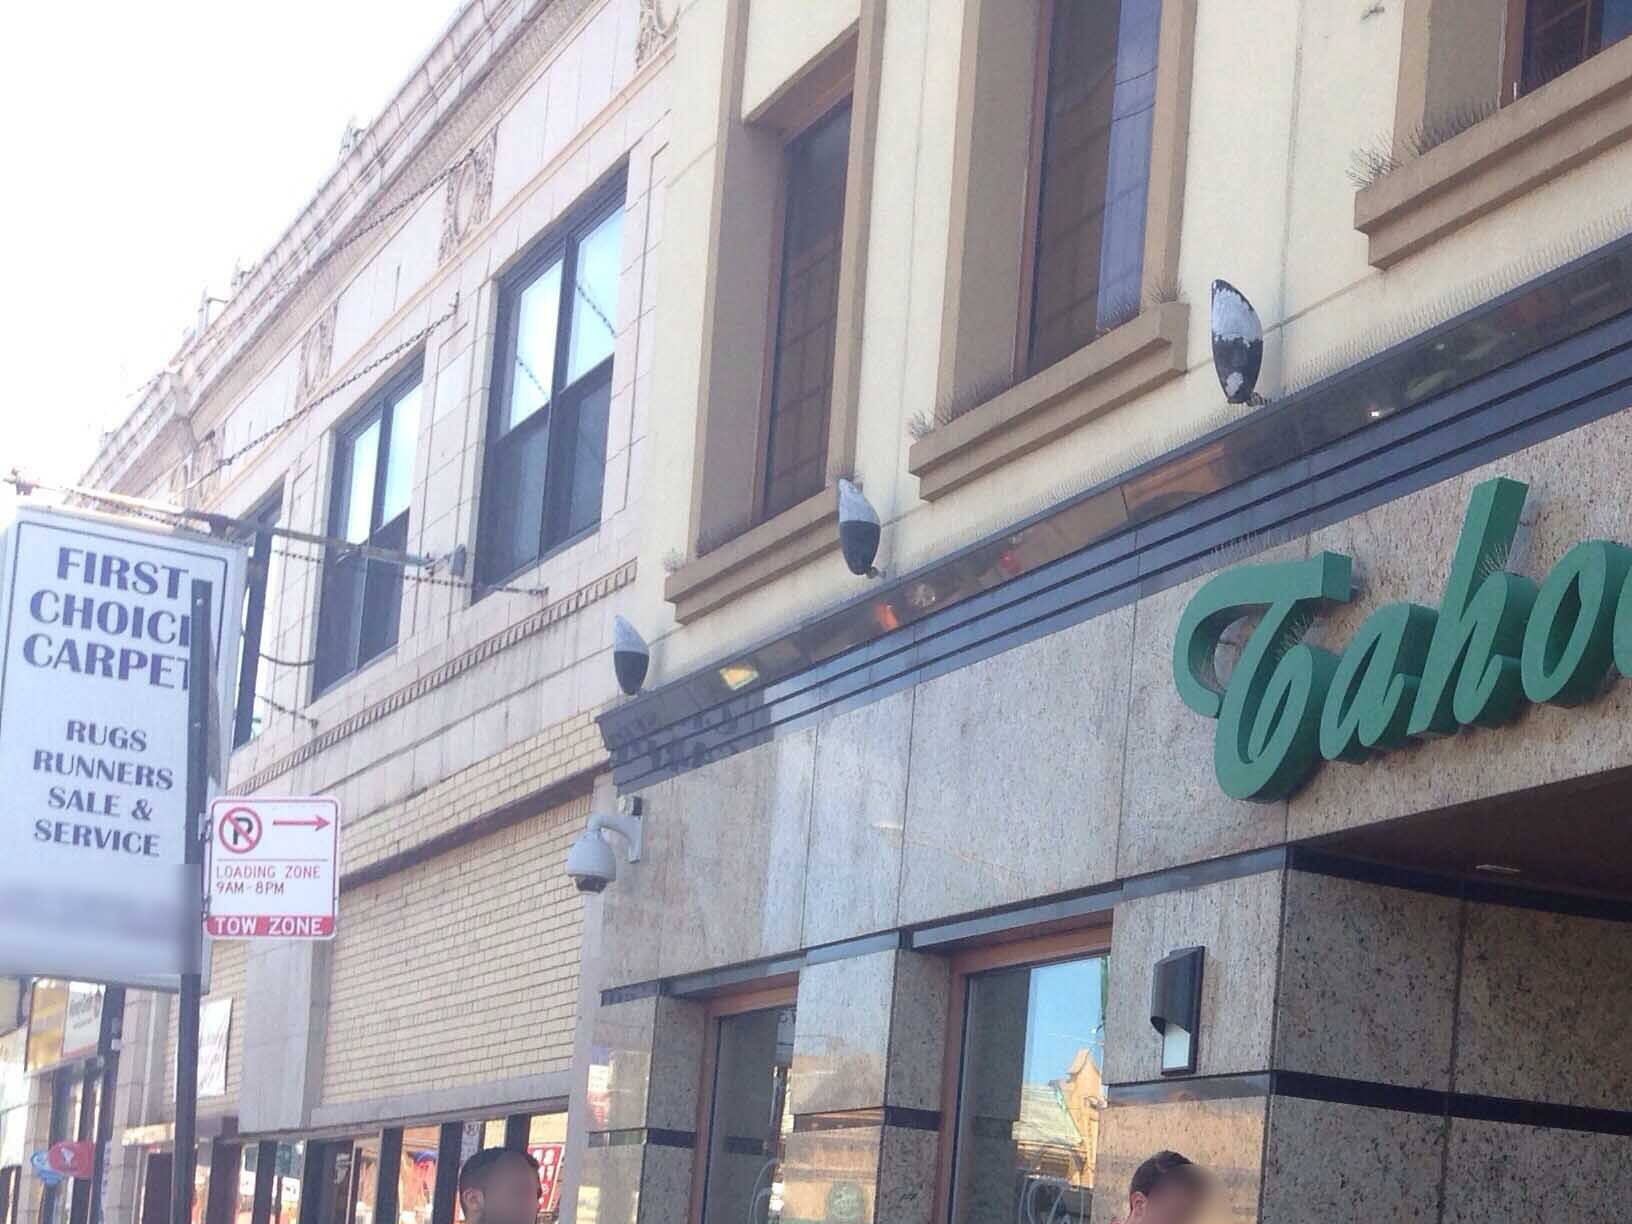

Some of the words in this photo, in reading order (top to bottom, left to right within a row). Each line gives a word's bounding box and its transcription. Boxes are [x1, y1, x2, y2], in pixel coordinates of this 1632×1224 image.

[57, 547, 189, 600] FIRST
[66, 720, 147, 752] RUGS
[33, 749, 174, 790] RUNNERS
[48, 785, 121, 818] SALE
[131, 798, 154, 821] &
[34, 818, 161, 858] SERVICE
[216, 865, 277, 880] LOADING
[285, 865, 321, 880] ZONE
[215, 917, 257, 935] TOW
[268, 917, 323, 935] ZONE
